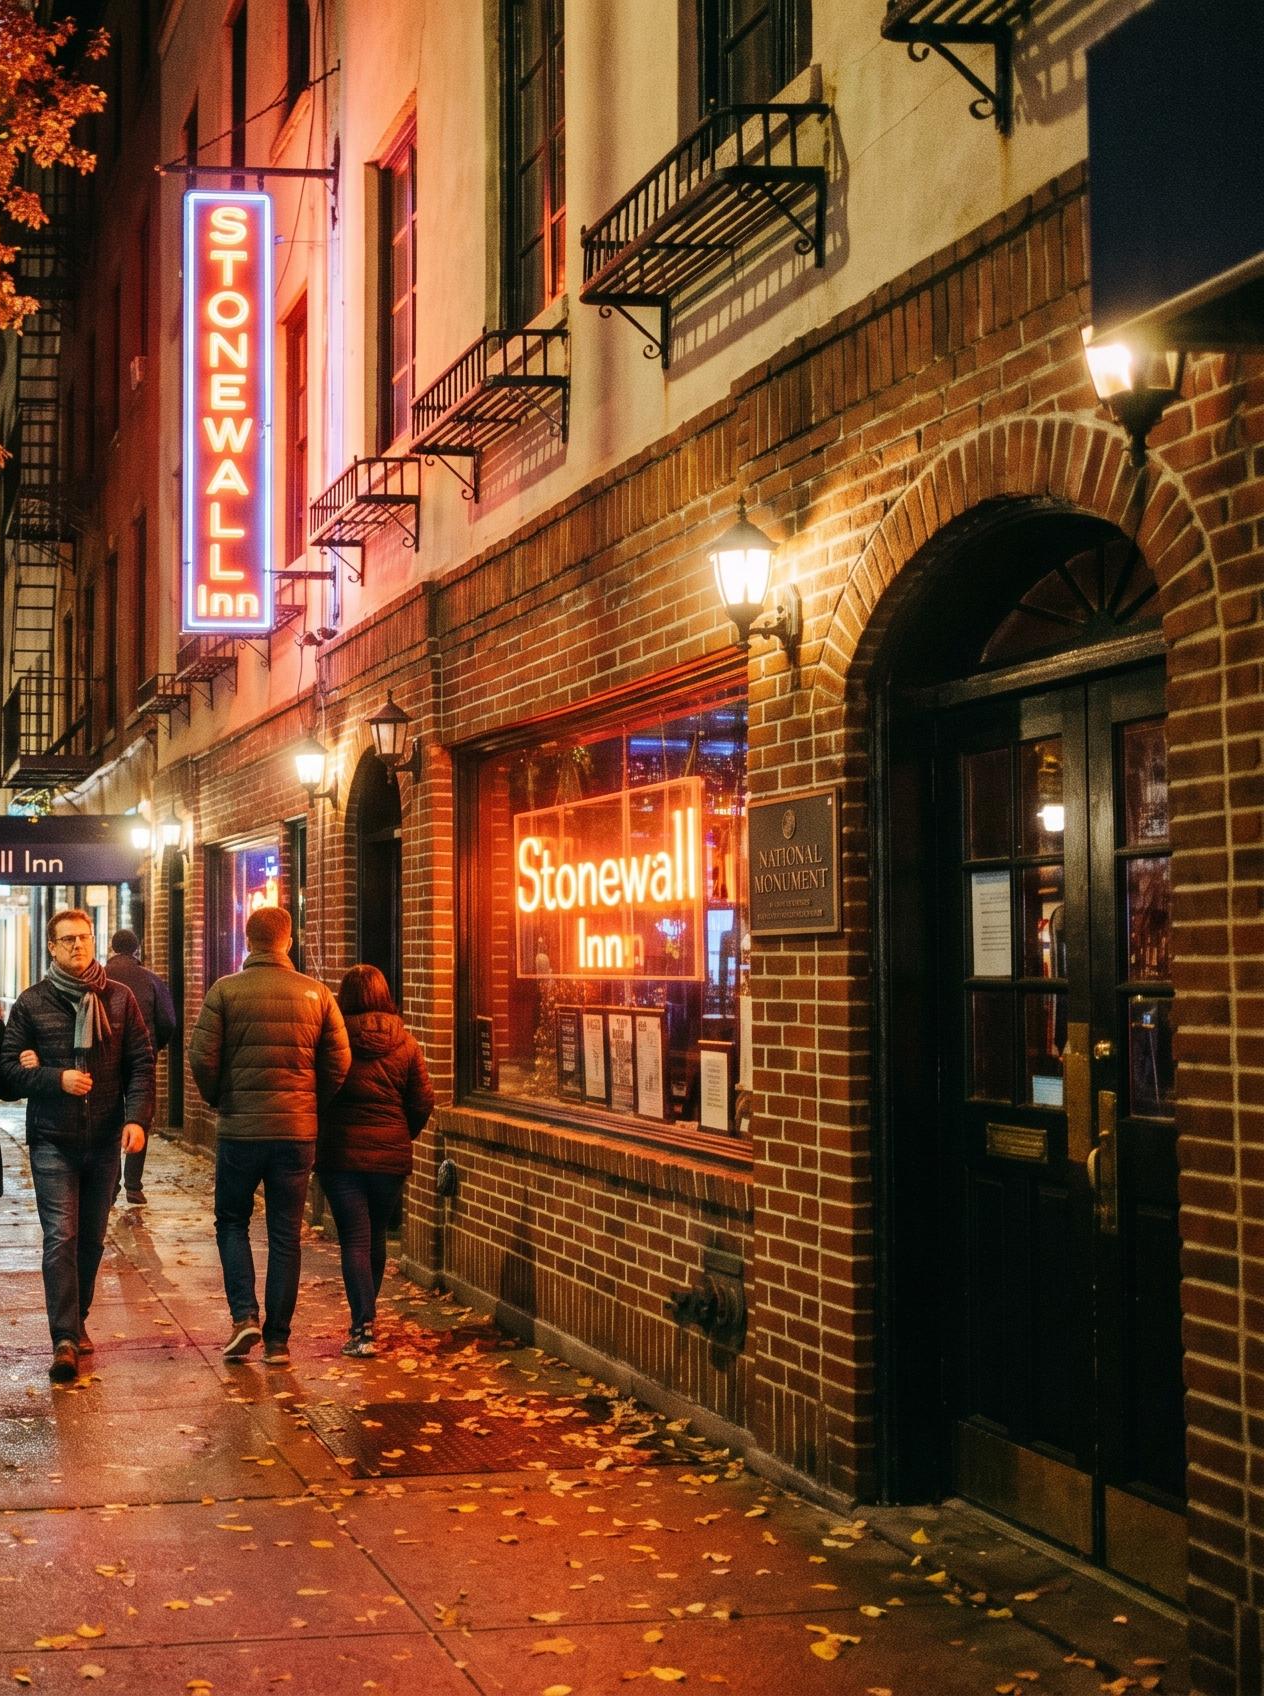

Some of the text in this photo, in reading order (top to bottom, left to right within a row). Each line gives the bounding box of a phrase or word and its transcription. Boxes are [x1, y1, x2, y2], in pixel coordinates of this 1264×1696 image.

[202, 206, 253, 582] STONEWALL
[197, 583, 260, 618] Inn
[25, 849, 64, 873] Inn
[517, 806, 697, 913] Stonewall
[758, 843, 823, 869] NATIONAL
[754, 867, 829, 893] MONUMENT
